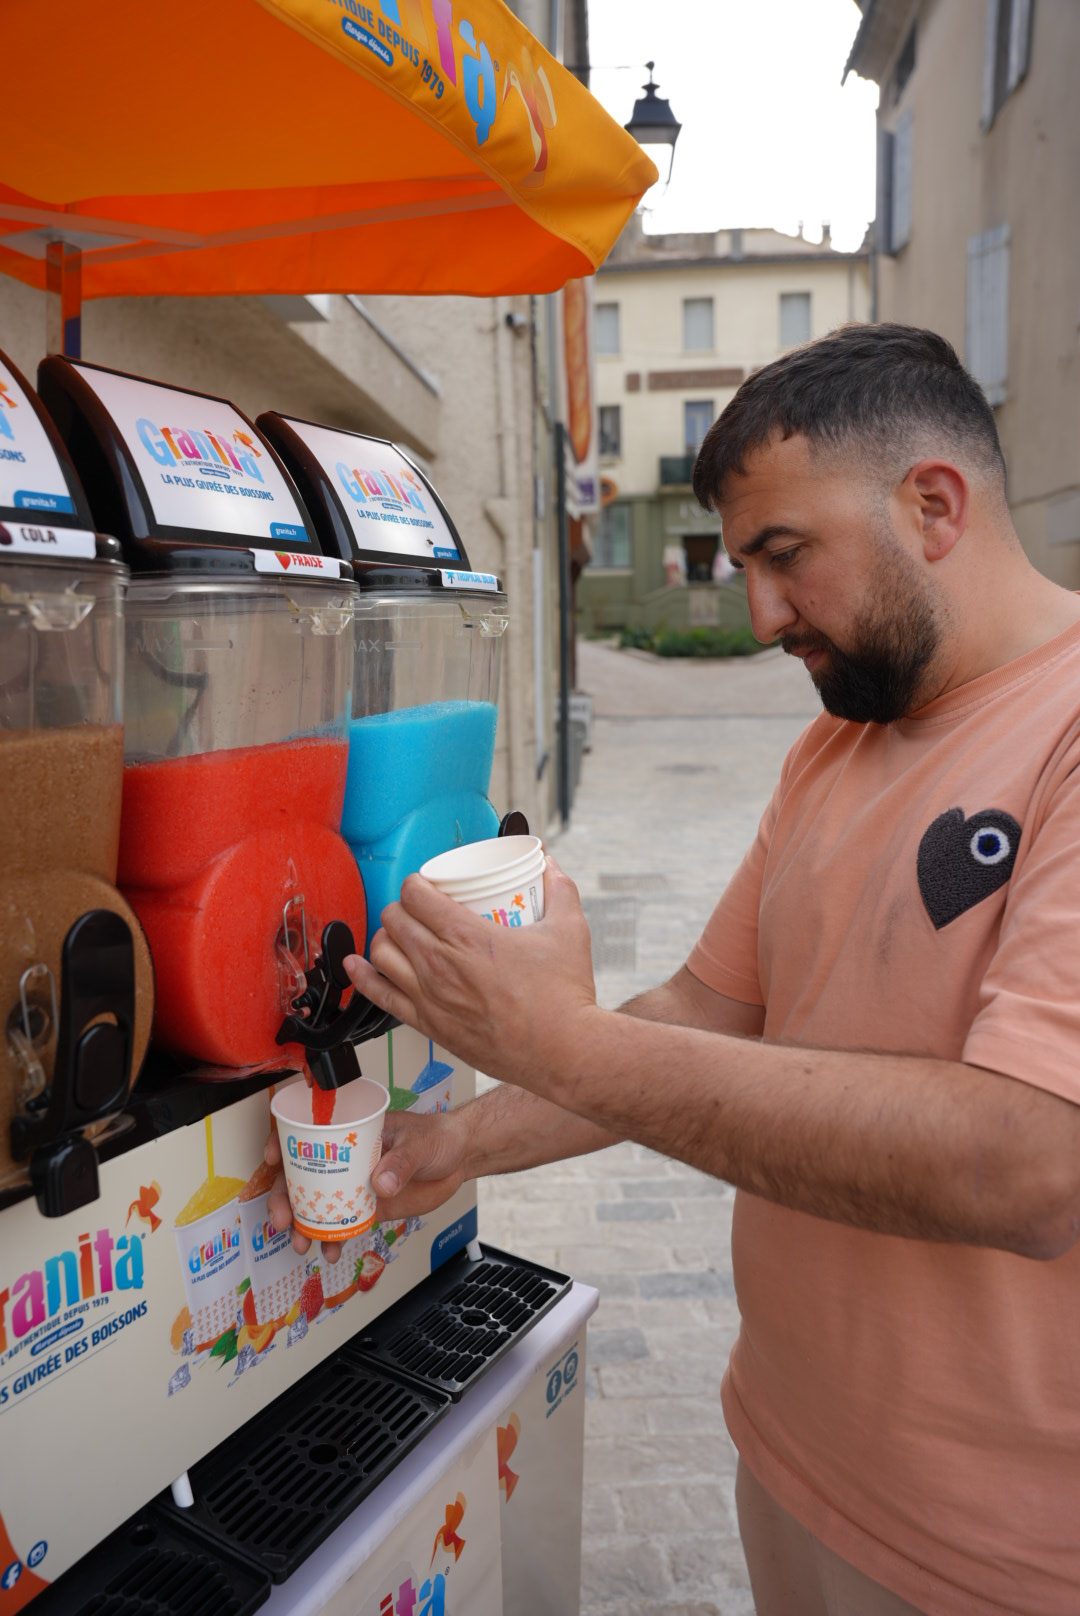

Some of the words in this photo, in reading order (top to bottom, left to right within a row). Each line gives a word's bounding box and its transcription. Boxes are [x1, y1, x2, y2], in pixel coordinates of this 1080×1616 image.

[377, 17, 420, 68] DEPUIS
[420, 58, 445, 100] 1979
[135, 417, 266, 484] Granita
[160, 473, 174, 485] LA
[175, 476, 195, 489] PLUS
[196, 479, 224, 493] GIVRÉE
[224, 484, 240, 496] DES
[239, 486, 274, 502] BOISSONS
[336, 462, 427, 514] Granita
[20, 527, 57, 544] COLA
[291, 554, 324, 569] FRAISE
[287, 1134, 351, 1163] Granita
[188, 1226, 241, 1274] Granita
[438, 1223, 464, 1250] granita.fr
[63, 1302, 90, 1321] DEPUIS
[92, 1296, 110, 1309] 1979
[12, 1354, 62, 1395] GIVRÉE
[65, 1336, 89, 1364] DES
[92, 1300, 148, 1347] BOISSONS
